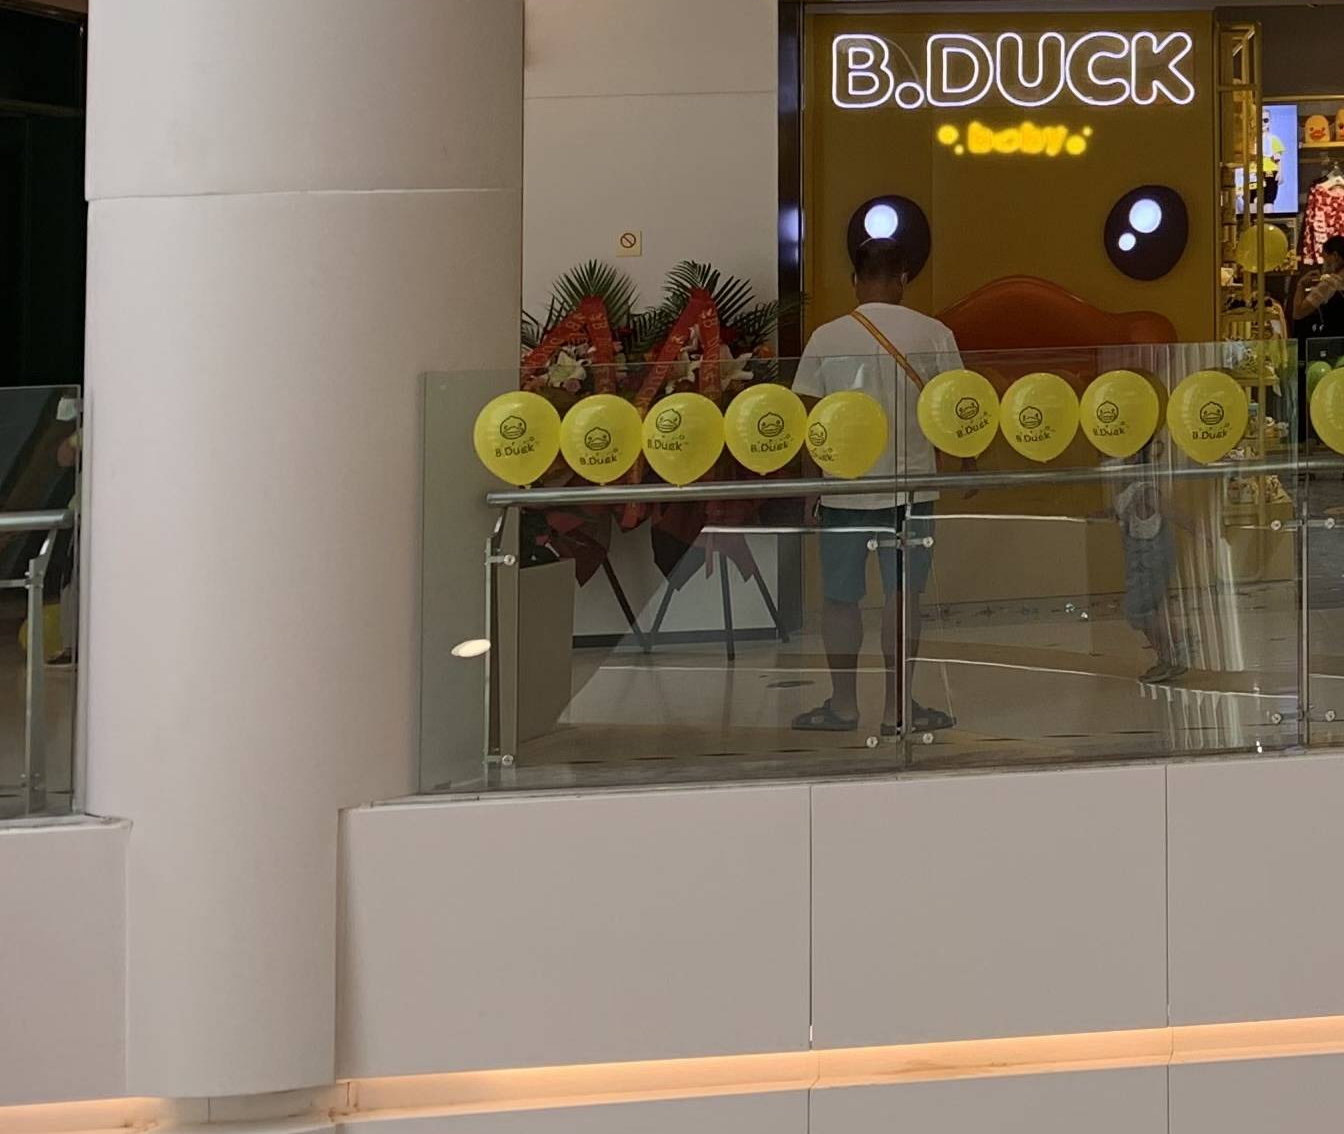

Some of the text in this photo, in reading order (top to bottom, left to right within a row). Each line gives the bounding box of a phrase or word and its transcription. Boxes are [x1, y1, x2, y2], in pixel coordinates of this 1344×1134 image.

[832, 31, 1195, 109] B.DUCK
[966, 120, 1066, 155] baby
[1015, 430, 1051, 444] B.Duck
[1192, 427, 1229, 440] B.Duck
[495, 442, 536, 458] B.Duck
[647, 438, 683, 452] B.Duck
[750, 440, 789, 454] B.Duck
[579, 453, 618, 467] B.Duck
